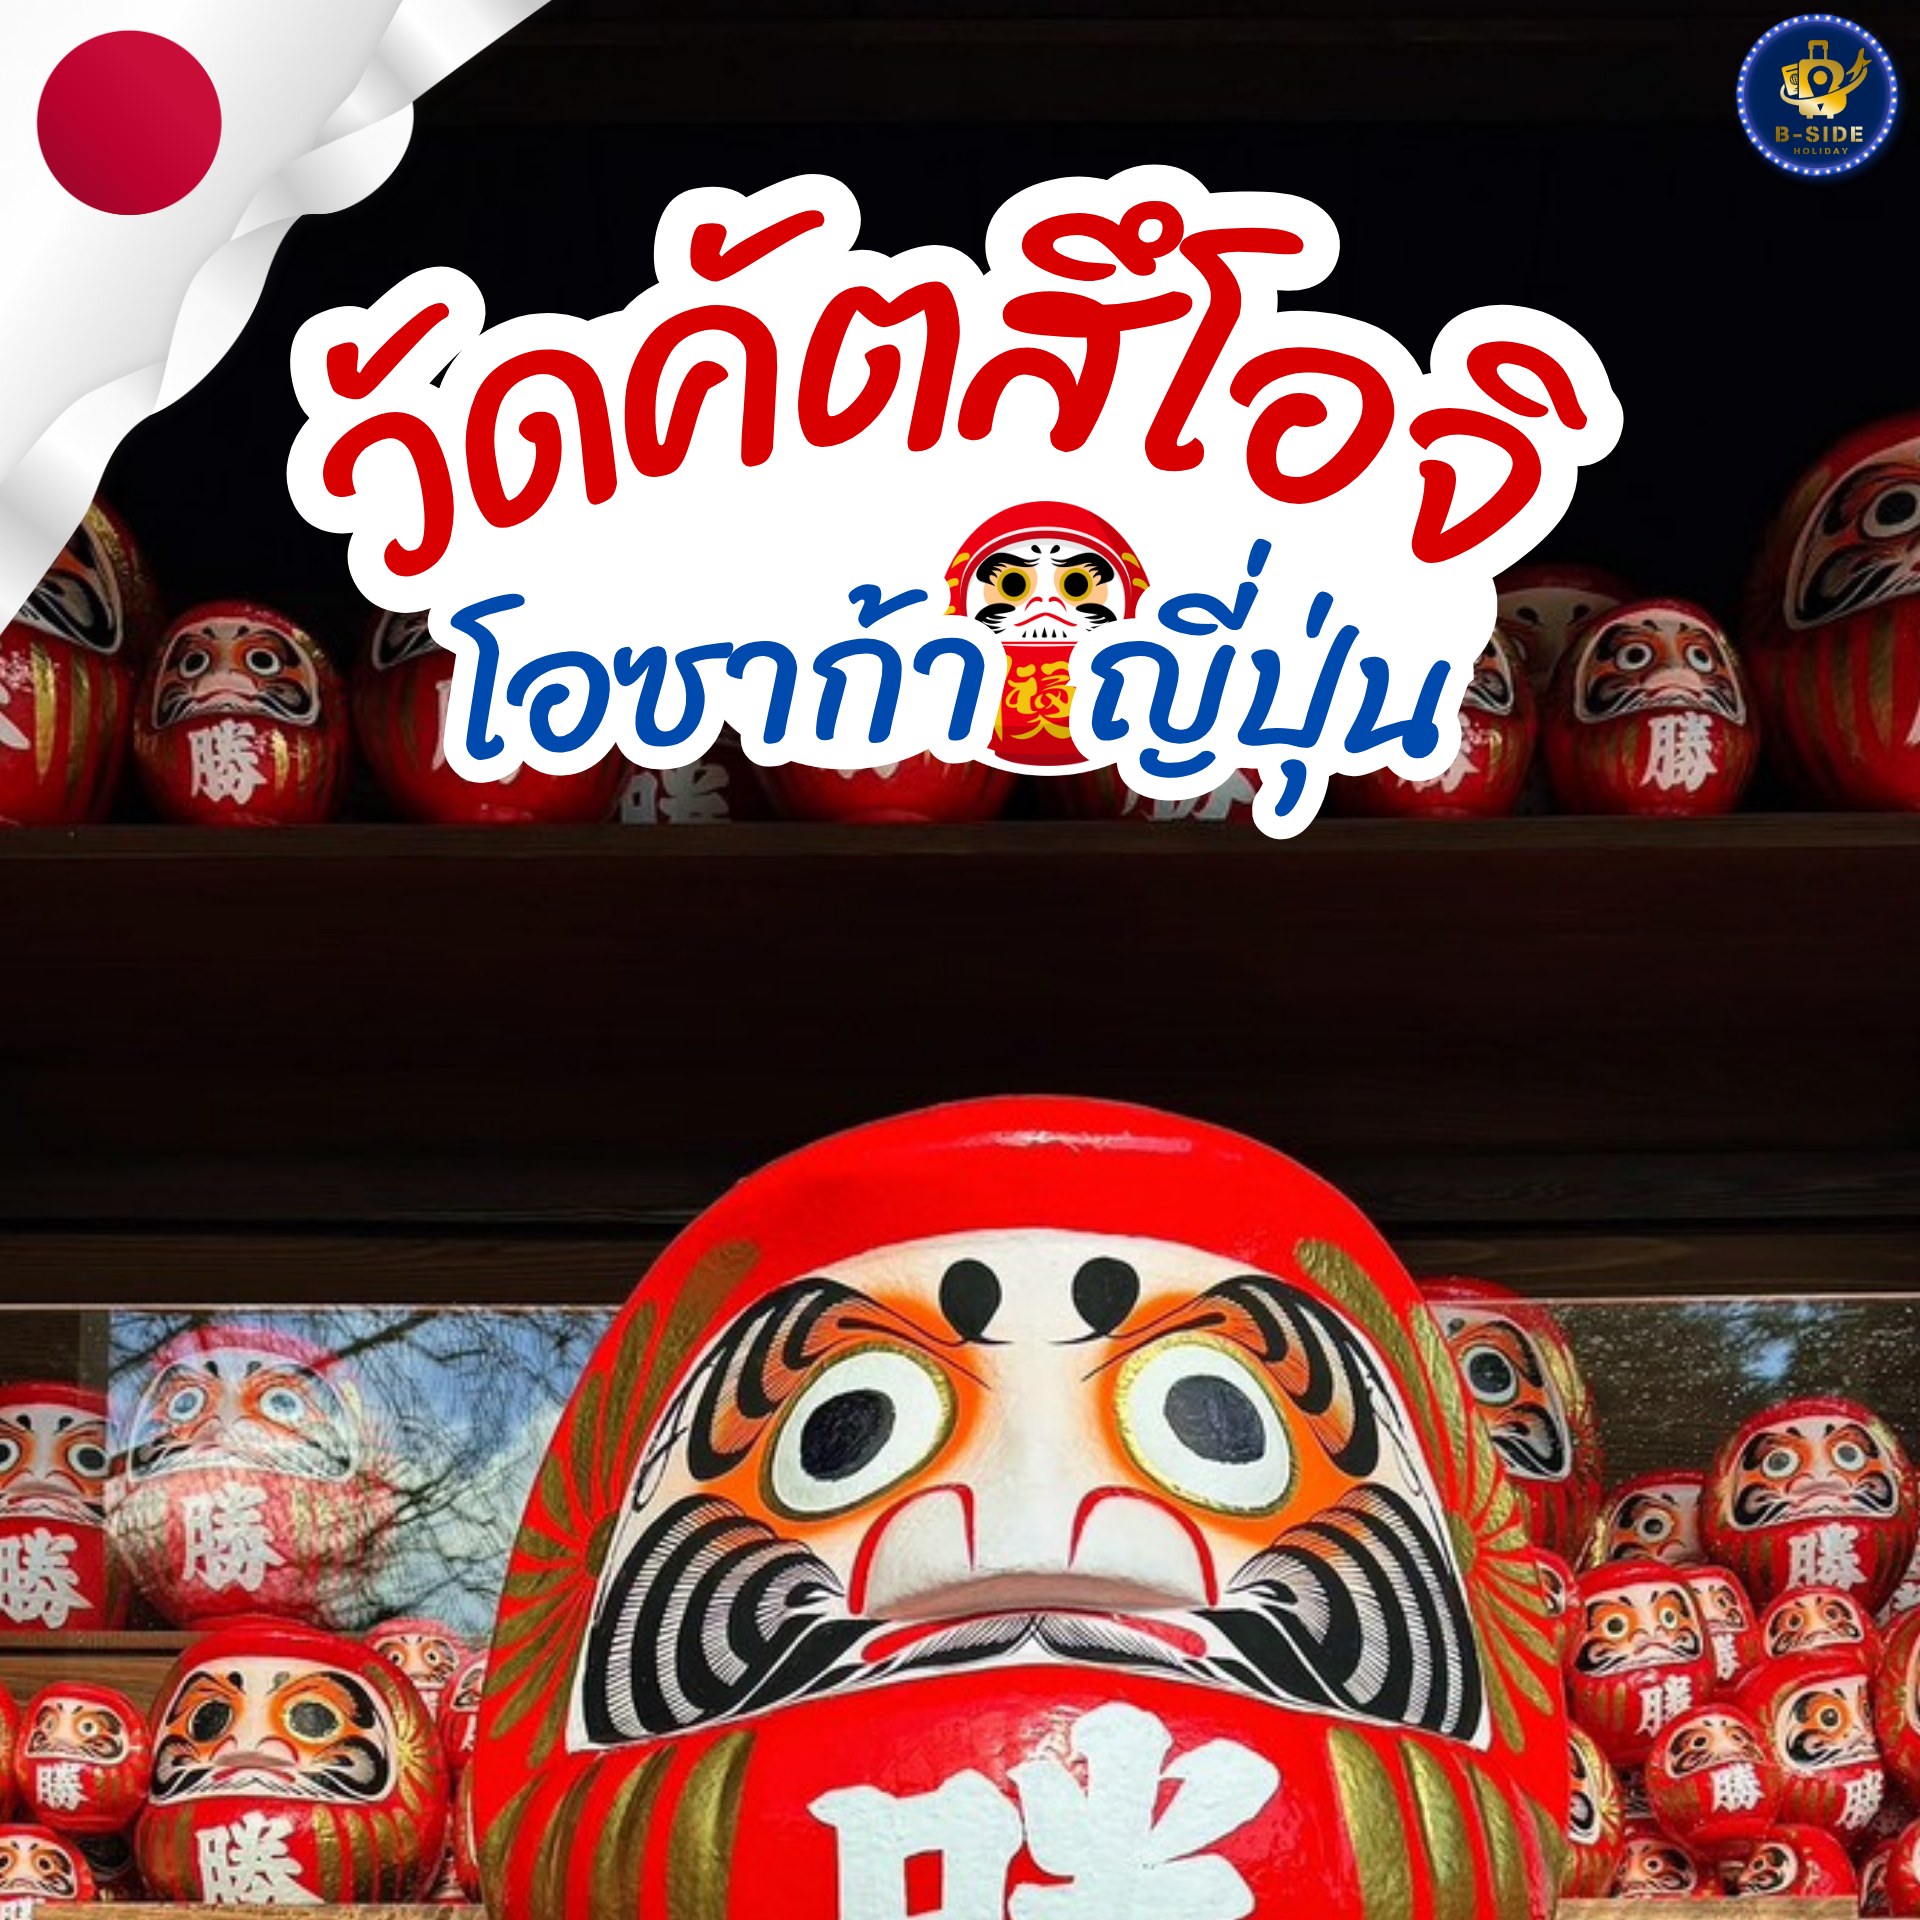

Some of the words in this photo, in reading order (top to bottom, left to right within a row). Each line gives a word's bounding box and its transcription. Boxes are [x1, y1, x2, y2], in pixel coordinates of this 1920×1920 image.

[188, 718, 267, 805] 勝
[1641, 711, 1719, 793] 勝
[182, 1481, 287, 1592] 勝
